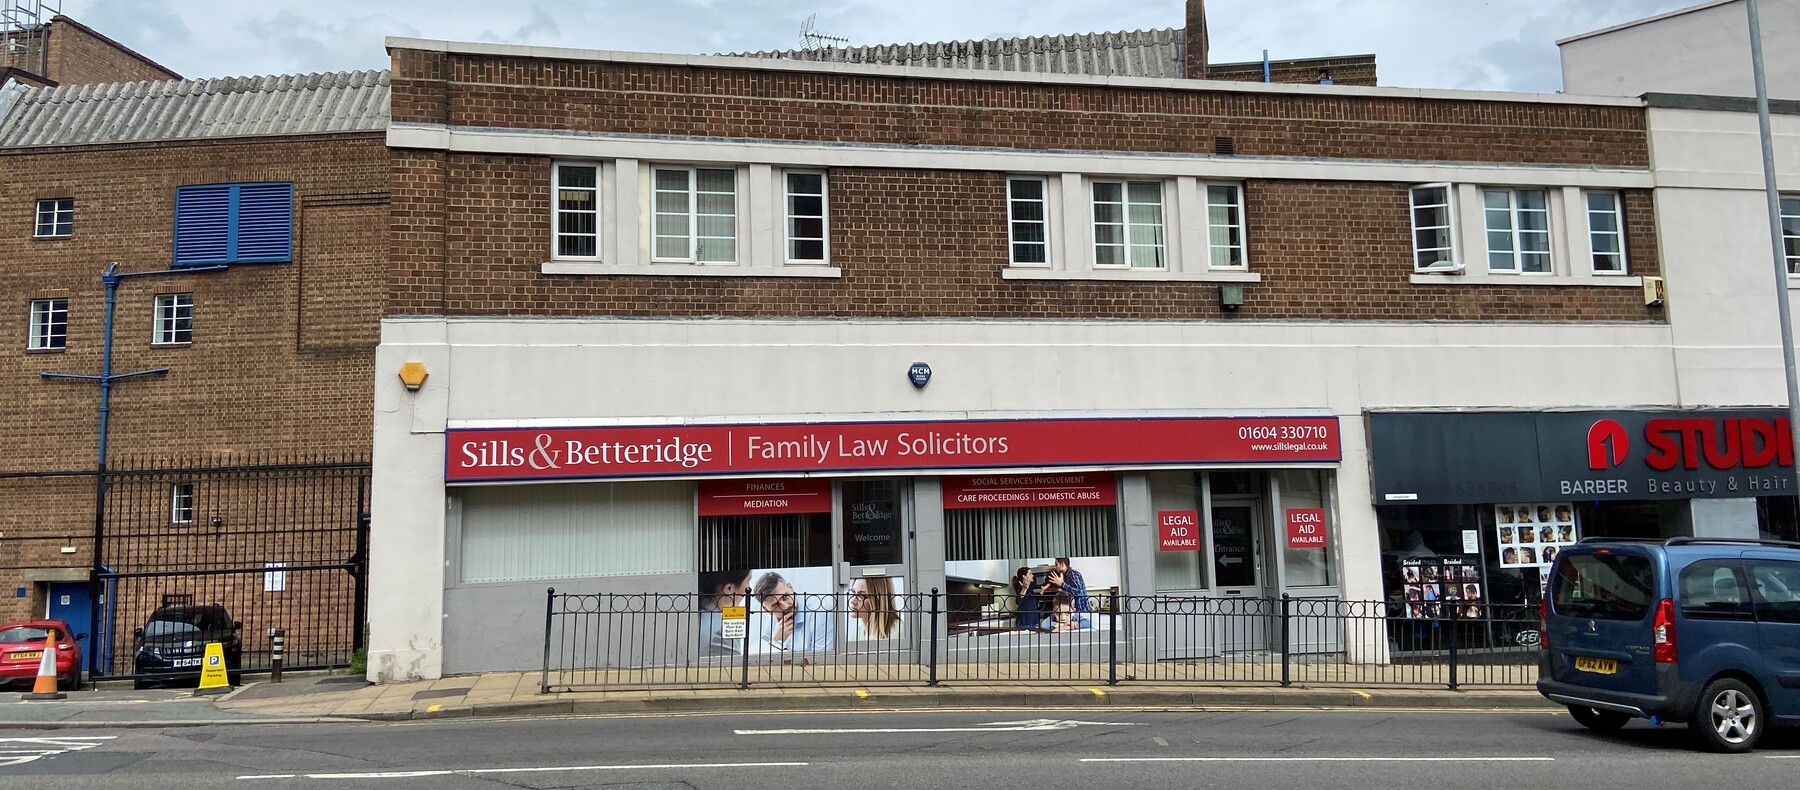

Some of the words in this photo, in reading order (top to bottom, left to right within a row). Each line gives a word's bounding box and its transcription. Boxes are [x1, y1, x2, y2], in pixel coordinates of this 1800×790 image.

[1238, 426, 1278, 439] 01604
[1280, 425, 1327, 439] 330710
[1251, 442, 1328, 453] www.sillslegal.co.uk
[1644, 417, 1794, 470] STUDI
[461, 440, 525, 468] Sills
[528, 433, 562, 470] &
[564, 437, 712, 468] Betteridge
[748, 434, 831, 464] Family
[838, 434, 889, 457] Law
[897, 431, 1009, 455] Solicitors
[972, 478, 998, 486] SOCIAL
[1000, 477, 1033, 485] SERVICES
[1034, 476, 1085, 484] INVOLVEMENT
[1648, 478, 1717, 495] Beauty
[1727, 476, 1738, 491] &
[1749, 475, 1788, 490] Hair
[746, 483, 785, 491] FINANCES
[1560, 479, 1628, 495] BARBER
[957, 494, 977, 502] CARE
[978, 493, 1030, 502] PROCEEDINGS
[1038, 492, 1076, 501] DOMESTIC
[1077, 491, 1101, 500] ABUSE
[743, 500, 788, 508] MEDIATION
[851, 503, 869, 511] Sills
[1163, 515, 1194, 526] LEGAL
[1291, 513, 1321, 523] LEGAL
[1170, 527, 1188, 537] AID
[1298, 524, 1315, 534] AID
[854, 534, 891, 542] Welcome
[1214, 544, 1246, 553] Entrance
